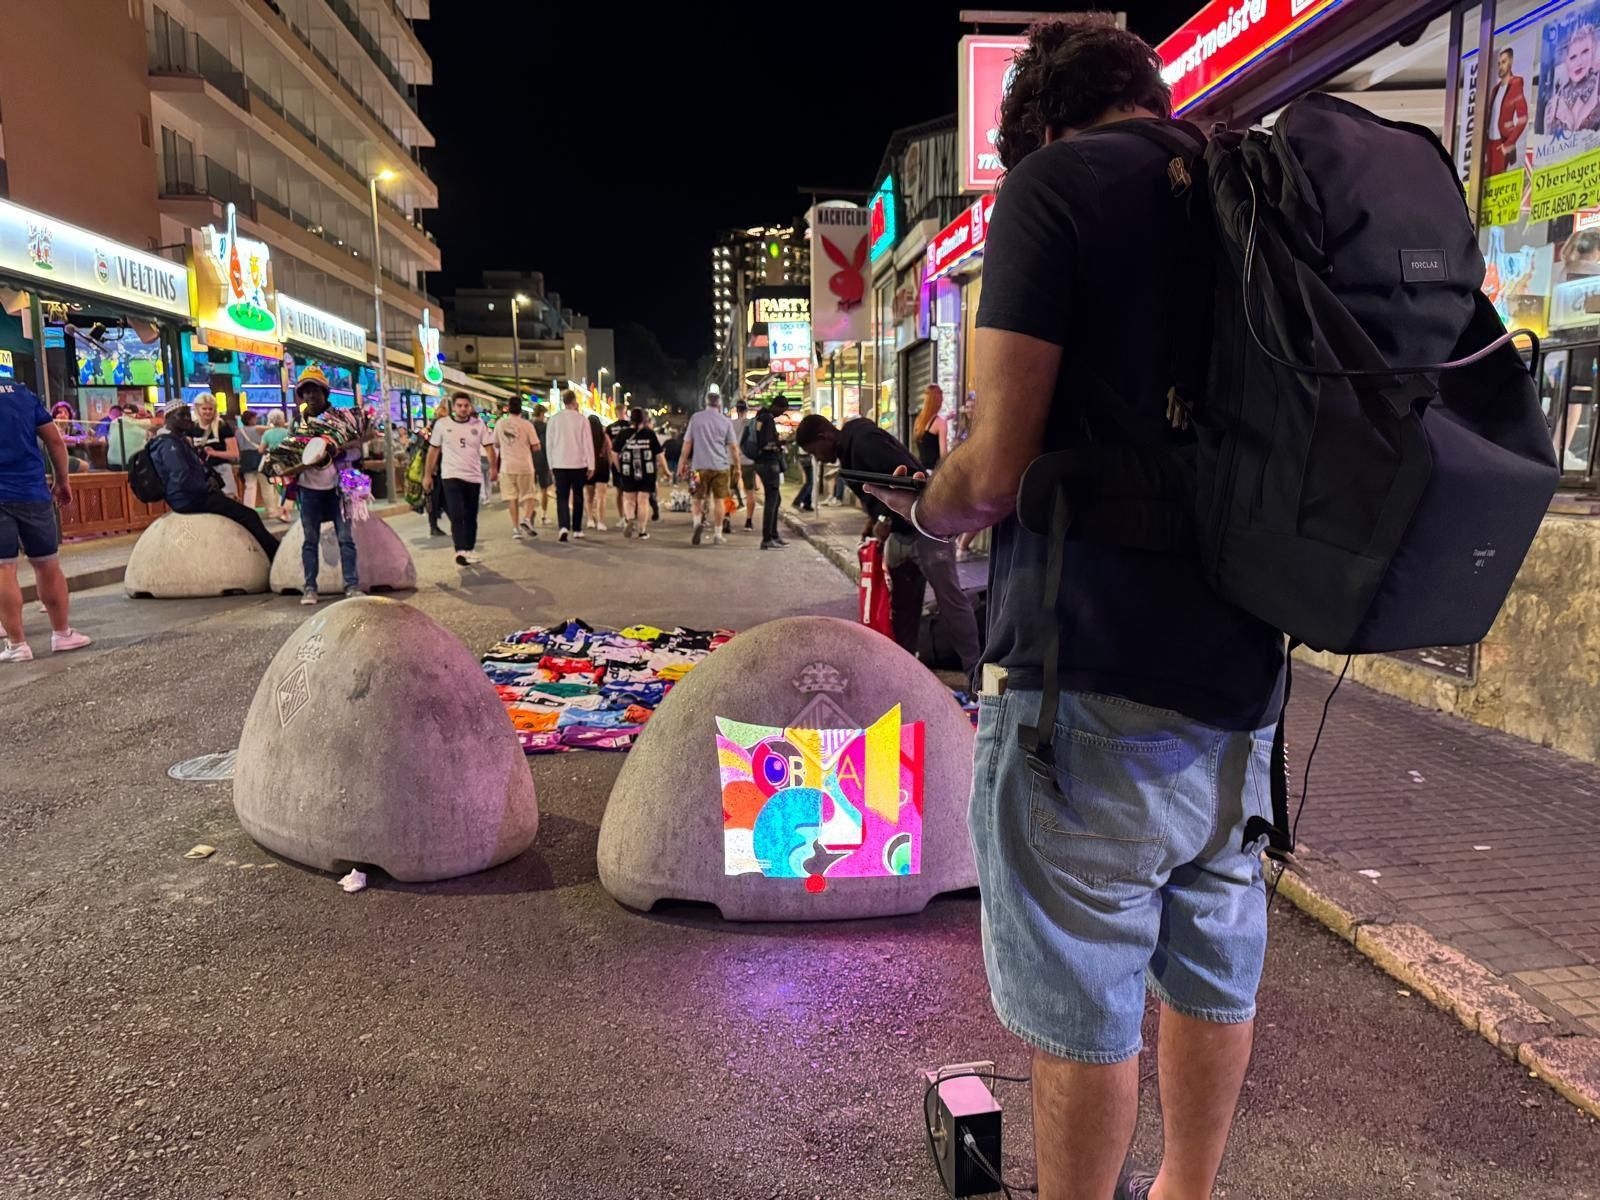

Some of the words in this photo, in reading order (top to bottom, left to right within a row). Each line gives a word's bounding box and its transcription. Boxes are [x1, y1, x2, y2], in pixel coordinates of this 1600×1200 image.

[1536, 160, 1600, 192] Oberbayer
[1584, 174, 1600, 190] LIV
[1482, 182, 1518, 203] bayern
[1531, 199, 1551, 220] EUTE
[1550, 191, 1577, 216] ABEND
[817, 208, 867, 226] NACHTCLUB
[117, 255, 177, 301] VELTINS
[759, 298, 810, 312] PARTY
[297, 311, 328, 341] VELTINS
[338, 327, 363, 353] VELTINS
